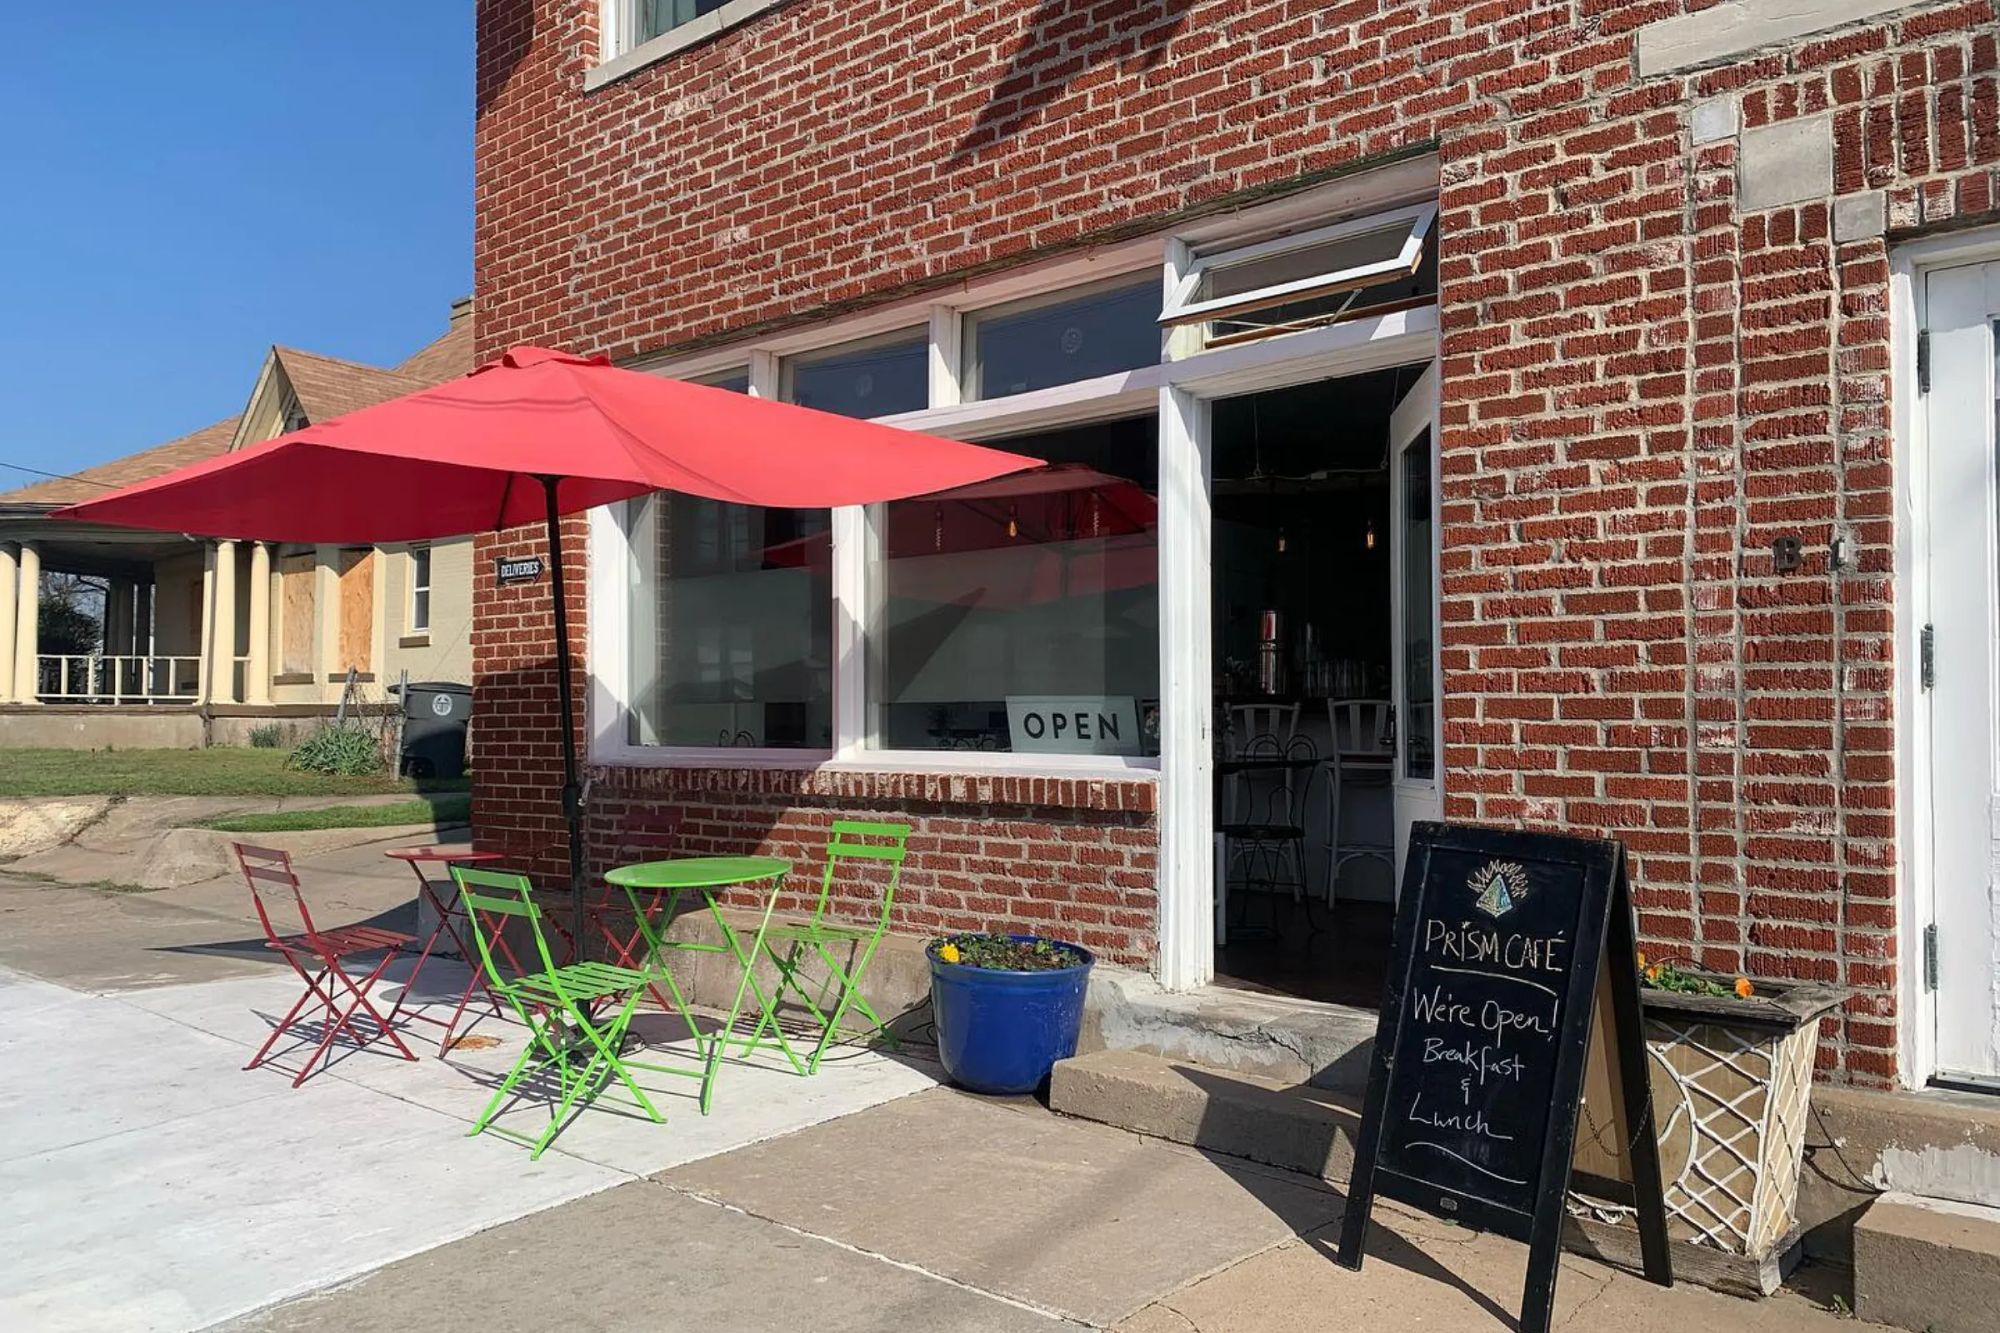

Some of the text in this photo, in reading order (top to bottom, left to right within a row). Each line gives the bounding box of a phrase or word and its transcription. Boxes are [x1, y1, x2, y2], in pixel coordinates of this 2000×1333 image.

[501, 561, 539, 577] DELIVERIES
[1023, 712, 1120, 740] OPEN
[1504, 930, 1566, 971] CAFÉ
[1413, 985, 1558, 1048] We're Open!
[1423, 1038, 1526, 1085] Breakfast
[1409, 1093, 1513, 1141] Lunch
